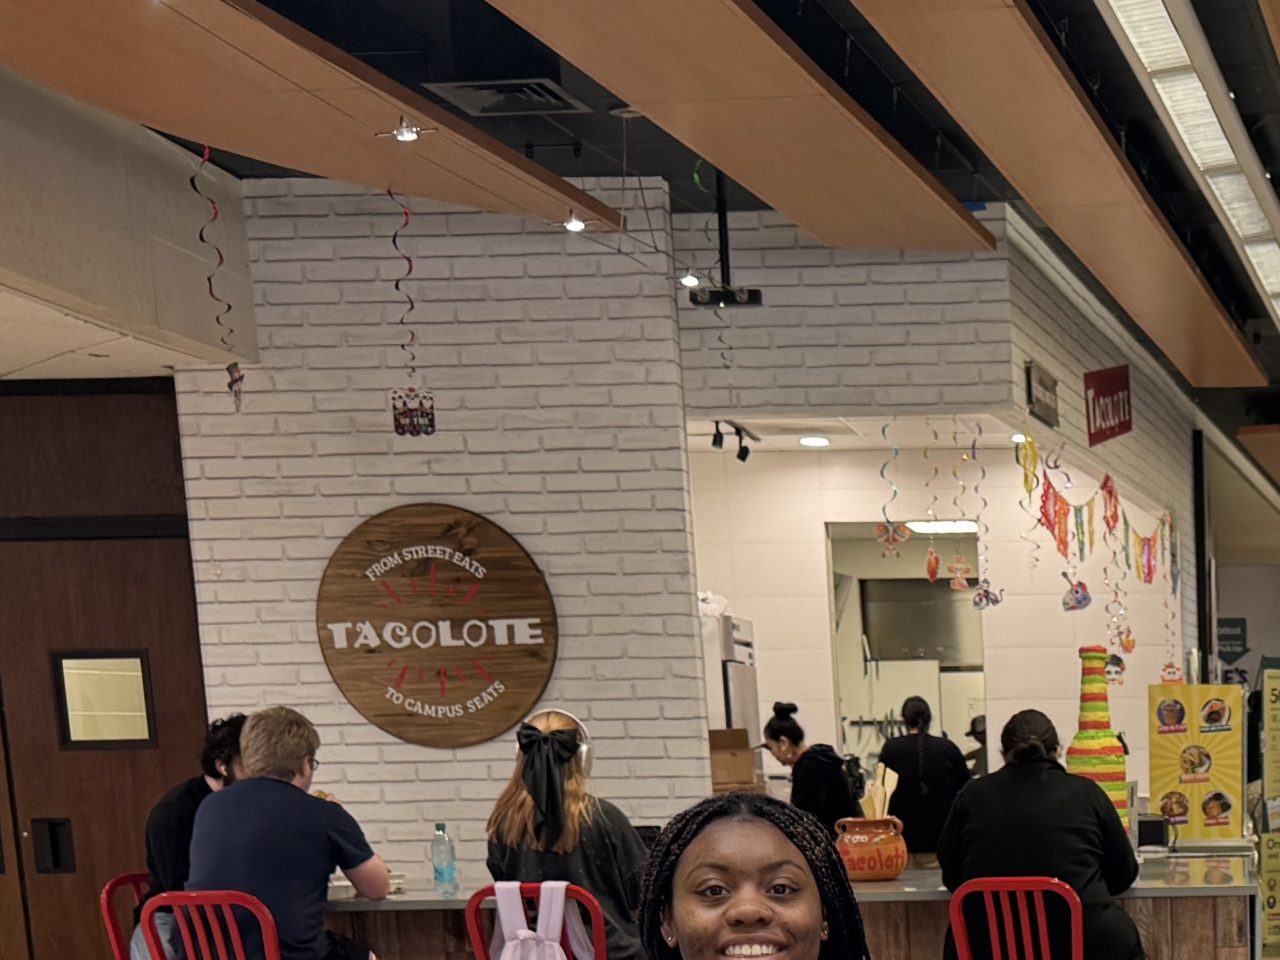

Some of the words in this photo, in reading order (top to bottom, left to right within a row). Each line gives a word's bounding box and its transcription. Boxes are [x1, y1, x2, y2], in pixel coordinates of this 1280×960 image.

[366, 556, 402, 582] FROM
[402, 545, 453, 562] STREET
[452, 552, 487, 580] EATS
[328, 618, 544, 649] TACOLOTE
[384, 686, 404, 706] TO
[404, 698, 464, 718] CAMPUS
[468, 680, 506, 713] SEATS
